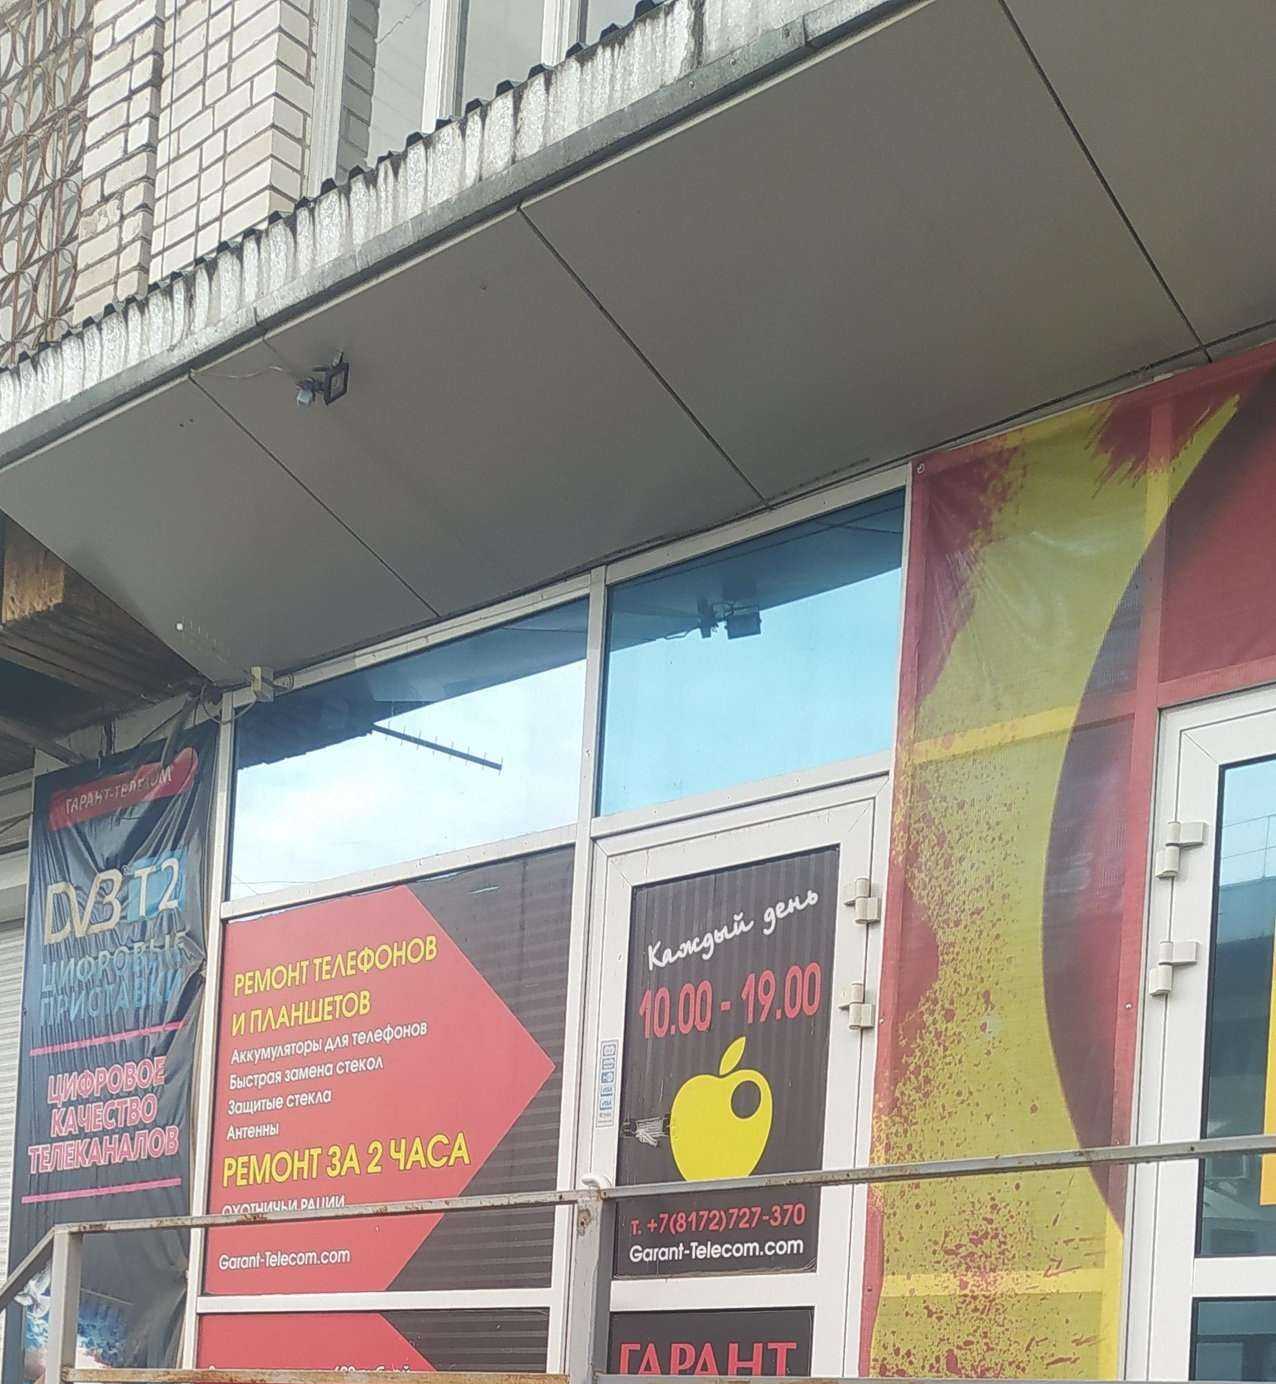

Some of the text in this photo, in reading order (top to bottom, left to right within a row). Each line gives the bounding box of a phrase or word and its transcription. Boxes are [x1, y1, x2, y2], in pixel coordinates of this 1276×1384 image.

[44, 857, 180, 944] DVB T2
[647, 890, 819, 971] Каждый день
[234, 934, 439, 997] РЕМОНТ ТЕЛЕФОНОВ
[231, 990, 371, 1037] И ПЛАНШЕТОВ
[639, 979, 713, 1039] 10.00
[741, 961, 823, 1024] 19.00
[231, 1020, 428, 1068] Аккумуляторы для телефонов
[48, 1056, 167, 1106] ЦИФРОВОЕ
[229, 1056, 384, 1092] Быстрая замена стекол
[50, 1093, 158, 1137] КАЧЕСТВО
[228, 1088, 332, 1116] Защитые стекла
[28, 1125, 180, 1174] ТЕЛЕКАНАЛОВ
[226, 1122, 279, 1141] Антенны
[223, 1131, 472, 1187] РЕМОНТ ЗА 2 ЧАСА
[646, 1203, 806, 1236] +7(8172)727-370
[218, 1248, 351, 1271] Garant-Telecom.com
[629, 1237, 804, 1264] Garant-Telecom.com
[618, 1342, 797, 1376] ГАРАНТ
